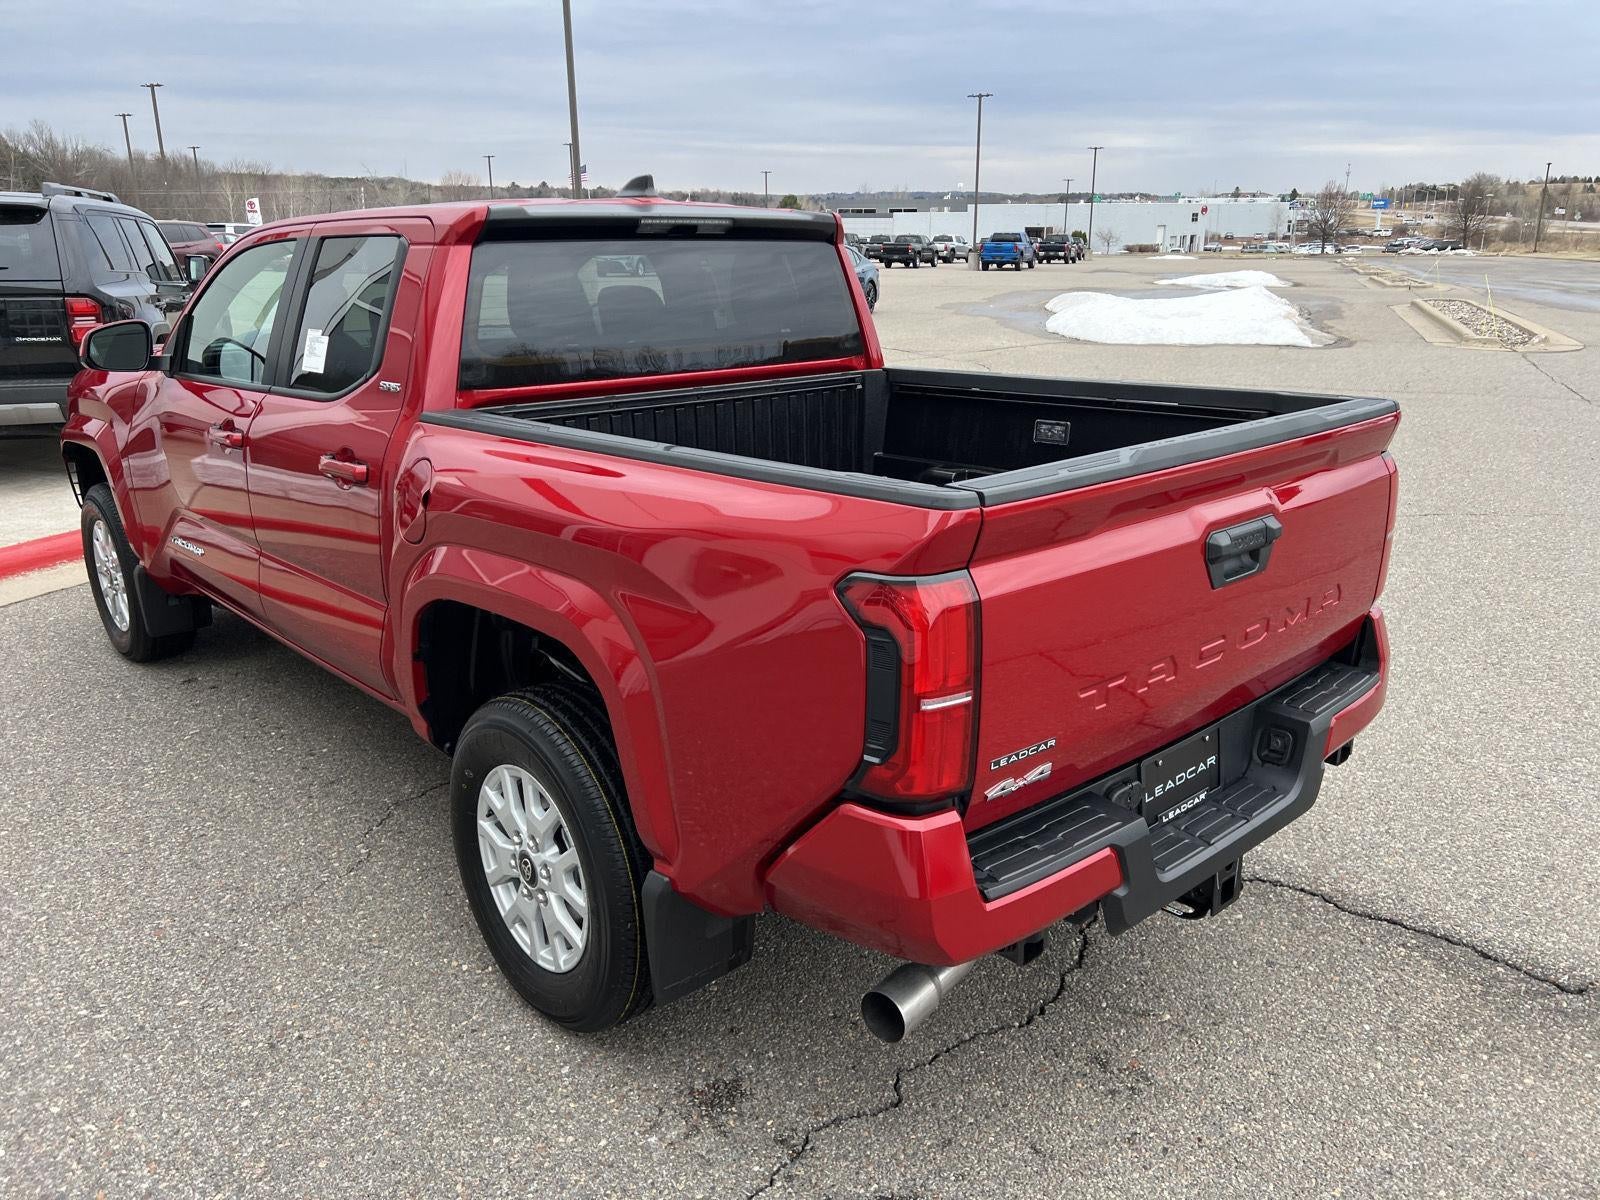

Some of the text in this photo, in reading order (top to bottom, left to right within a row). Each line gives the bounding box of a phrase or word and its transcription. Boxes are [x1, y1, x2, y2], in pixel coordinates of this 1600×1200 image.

[1078, 583, 1342, 710] TACOMA
[990, 739, 1056, 770] LEADCAR
[1145, 755, 1216, 803] LEADCAR
[1162, 792, 1206, 823] LEADCAR
